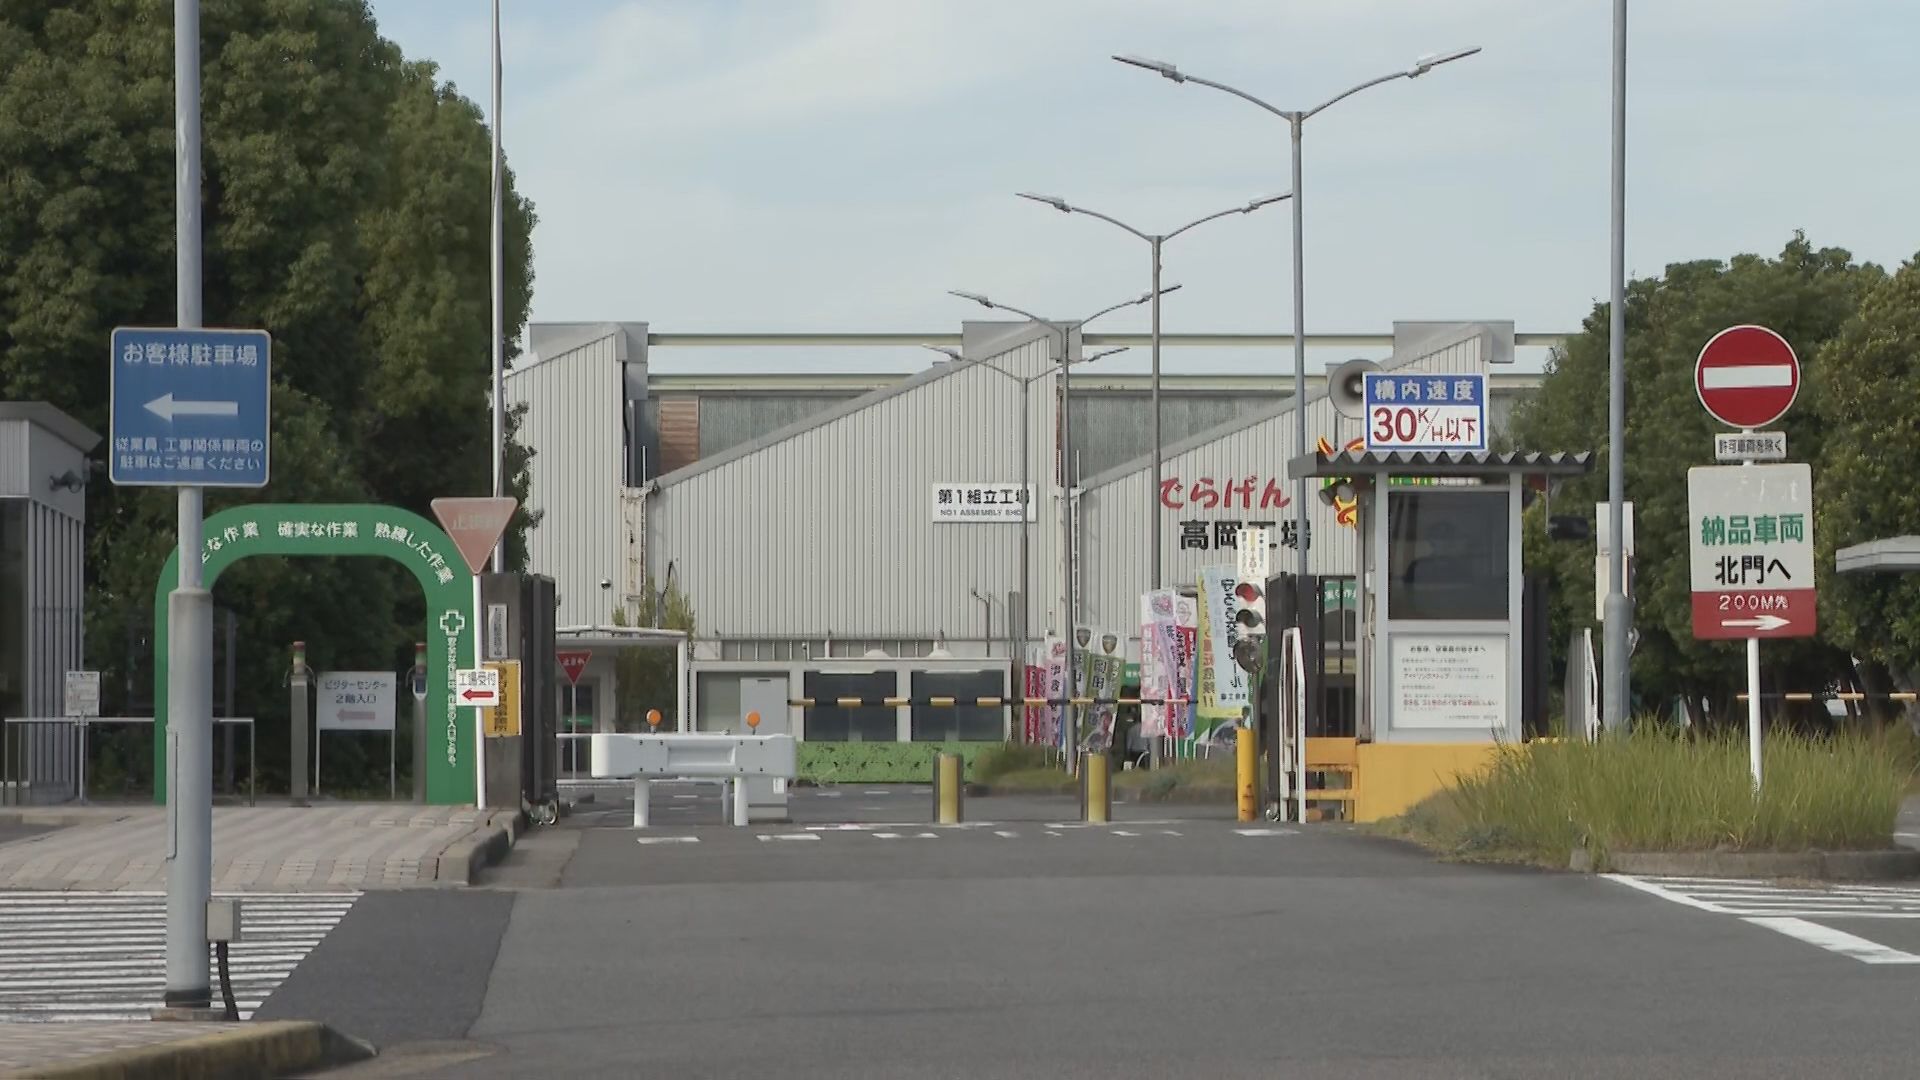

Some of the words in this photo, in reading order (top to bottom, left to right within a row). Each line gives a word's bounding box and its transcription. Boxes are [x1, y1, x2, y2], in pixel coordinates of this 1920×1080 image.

[123, 342, 258, 367] お客様駐車場
[1374, 379, 1475, 401] 構内速度
[1718, 439, 1782, 454] 許可車両を除く
[119, 455, 261, 471] 駐車はご遠慮ください
[1160, 474, 1291, 510] でらげん
[1005, 509, 1023, 517] SHO
[1701, 513, 1804, 546] 納品車両
[278, 521, 358, 539] 確実な作業
[375, 521, 454, 585] 熟練した作業
[1714, 555, 1792, 586] 北門へ
